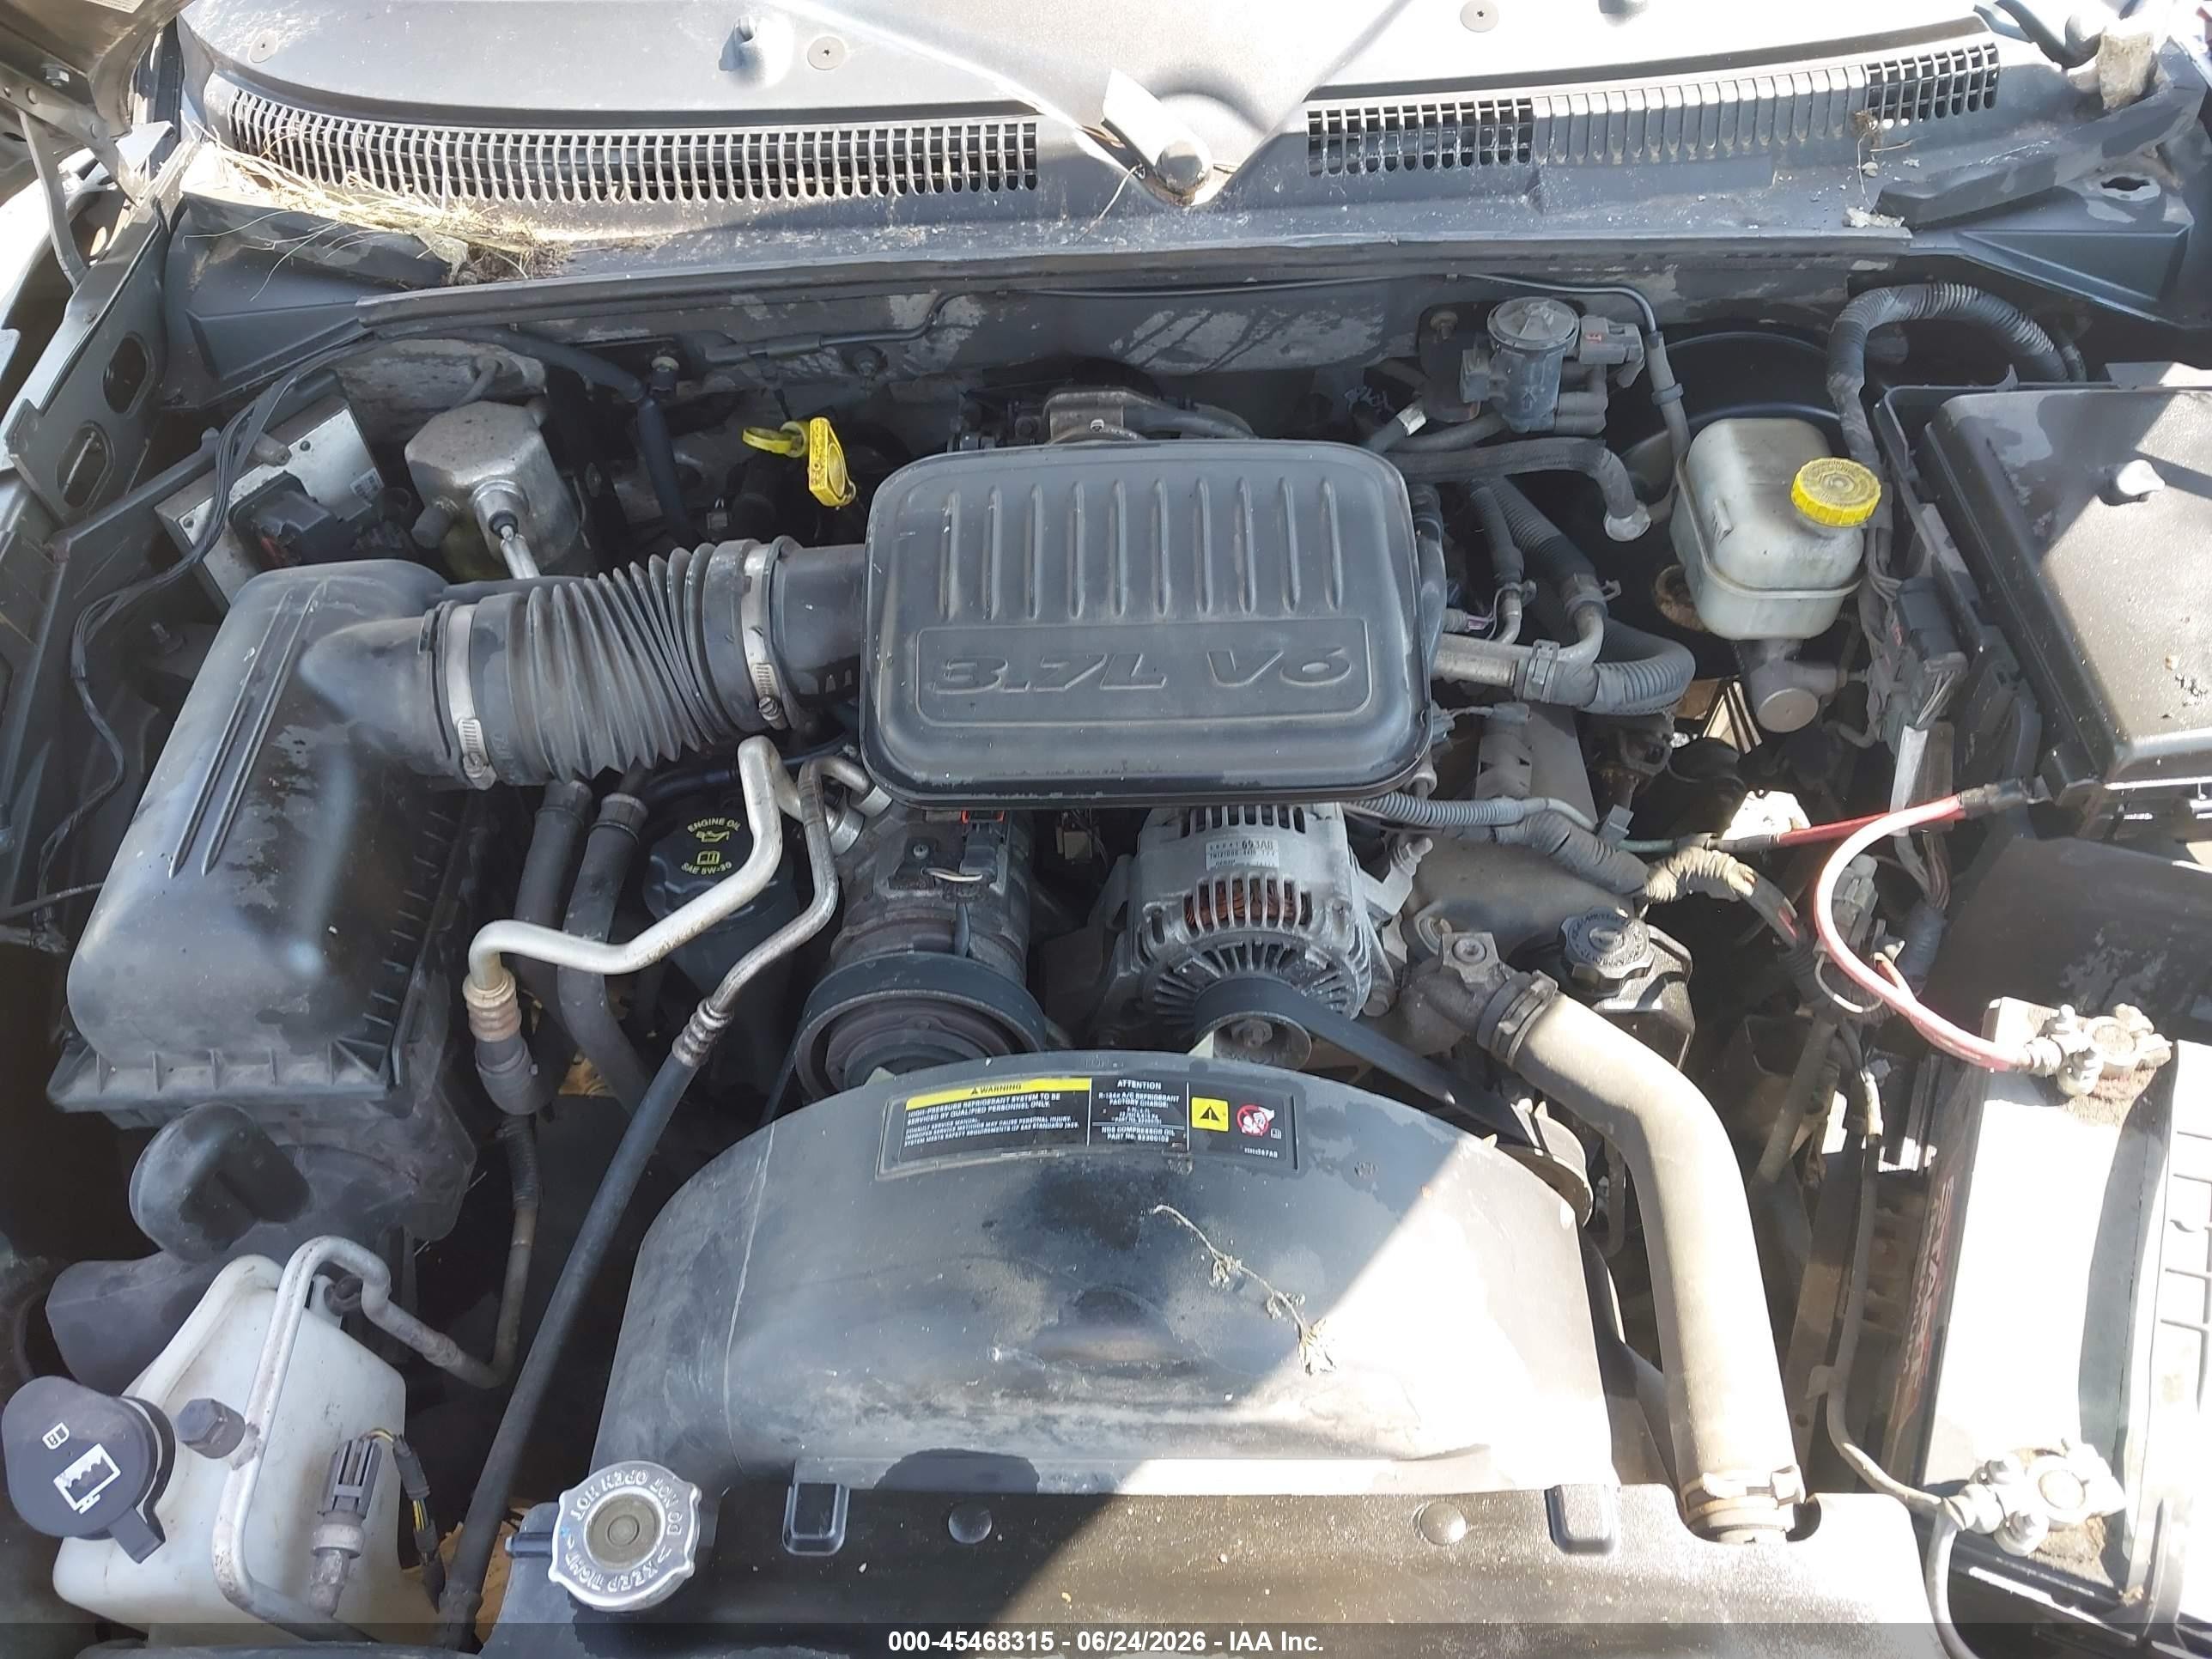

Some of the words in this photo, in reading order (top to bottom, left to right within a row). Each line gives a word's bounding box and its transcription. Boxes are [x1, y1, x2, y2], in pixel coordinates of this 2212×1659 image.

[933, 653, 1167, 695] 3.7L
[1205, 646, 1353, 687] V6
[687, 817, 726, 832] ENGINE
[726, 819, 741, 831] OIL
[681, 862, 700, 875] SAE
[701, 861, 732, 875] 5W-30
[980, 1083, 1022, 1094] WARNING
[1117, 1079, 1162, 1091] ATTENTION
[1012, 1093, 1038, 1103] SYSTEM
[1051, 1092, 1061, 1101] BE
[950, 1107, 986, 1118] QUALIFIED
[988, 1103, 1030, 1113] PERSONNEL
[600, 1469, 647, 1492] OPEN
[570, 1485, 600, 1522] HOT
[649, 1478, 679, 1509] NOT
[667, 1511, 683, 1535] DO
[565, 1551, 605, 1590] TIGHT
[607, 1560, 659, 1593] KEEP
